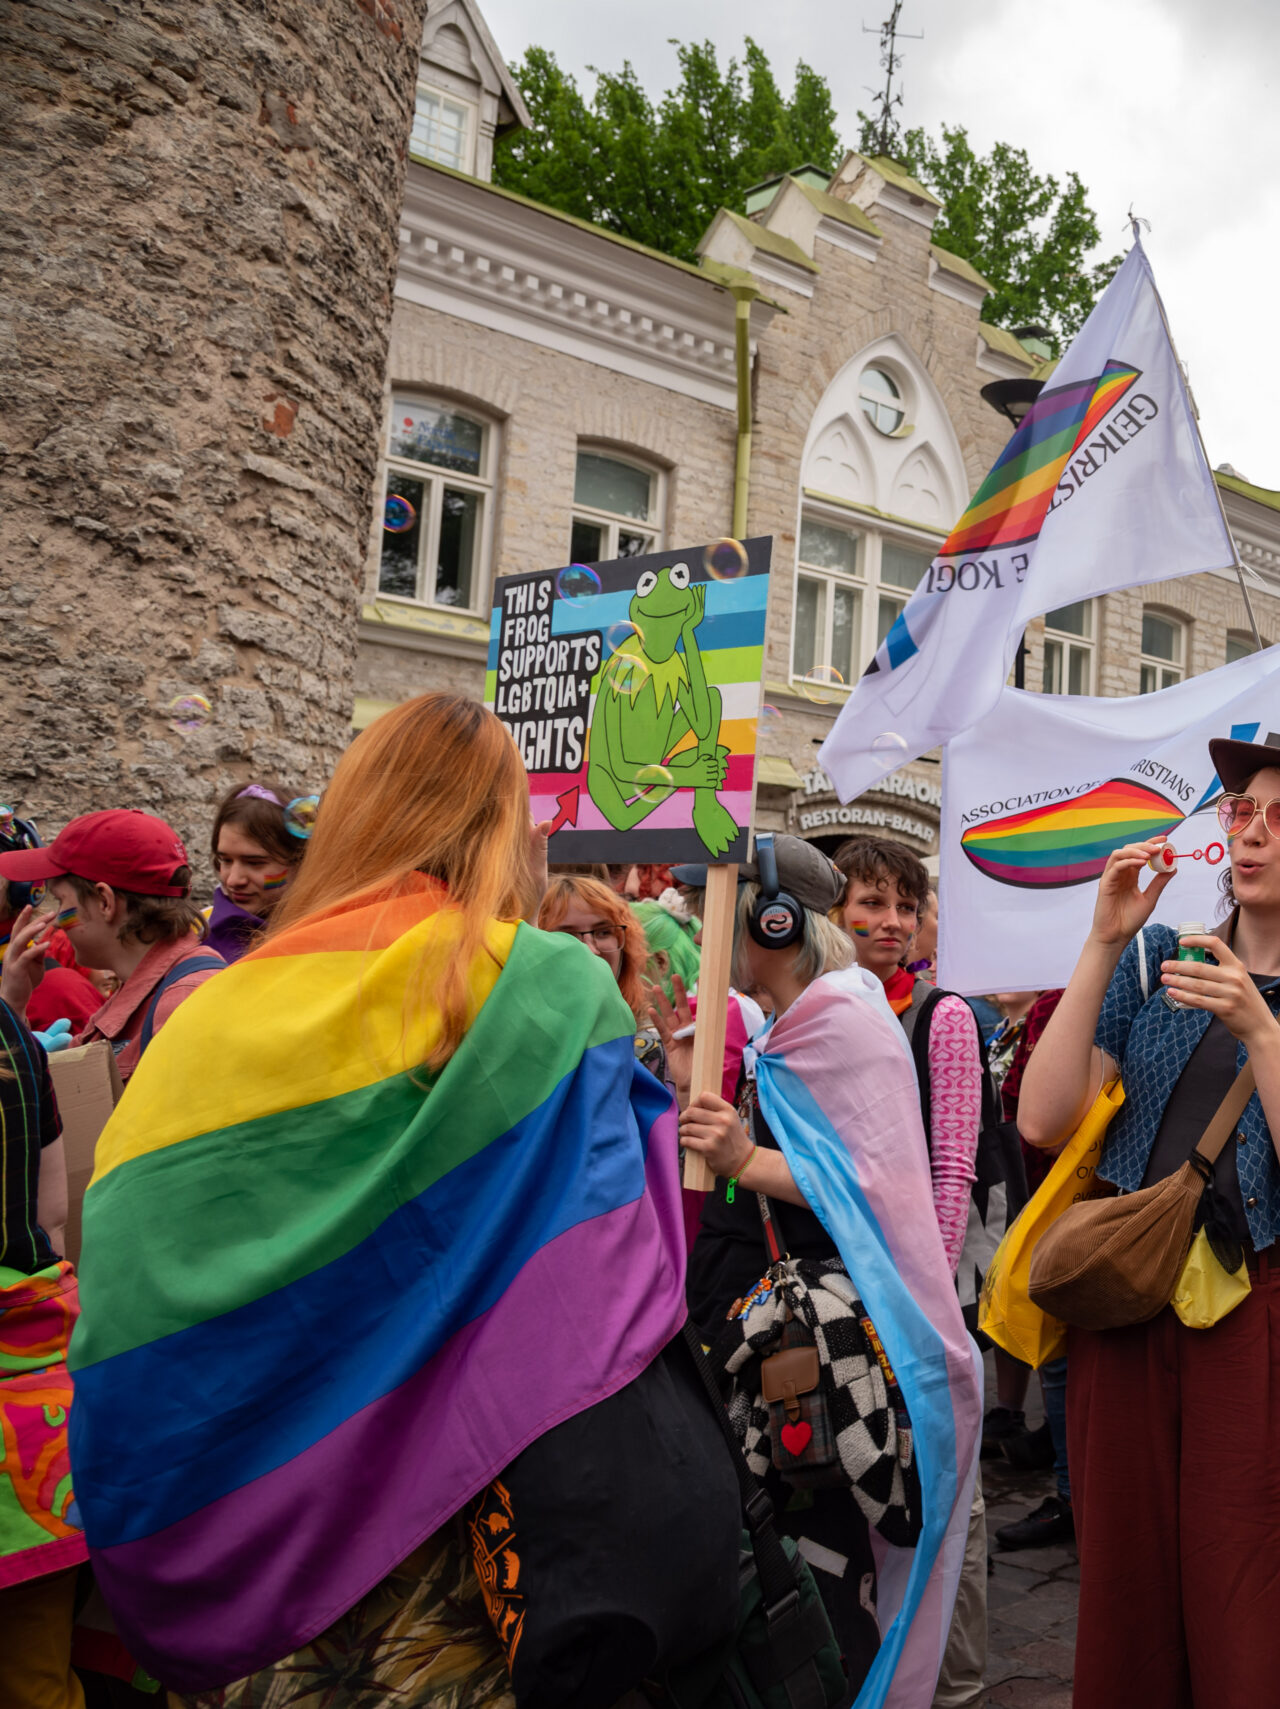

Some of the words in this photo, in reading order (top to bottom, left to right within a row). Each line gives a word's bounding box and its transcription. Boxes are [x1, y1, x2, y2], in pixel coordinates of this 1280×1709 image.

[505, 580, 551, 614] THIS
[504, 615, 549, 647] FROG
[499, 635, 600, 682] SUPPORTS
[497, 675, 589, 714] LGBTQIA+
[799, 807, 936, 843] RESTORAN-BAAR
[960, 785, 1076, 829] ASSOCIATION
